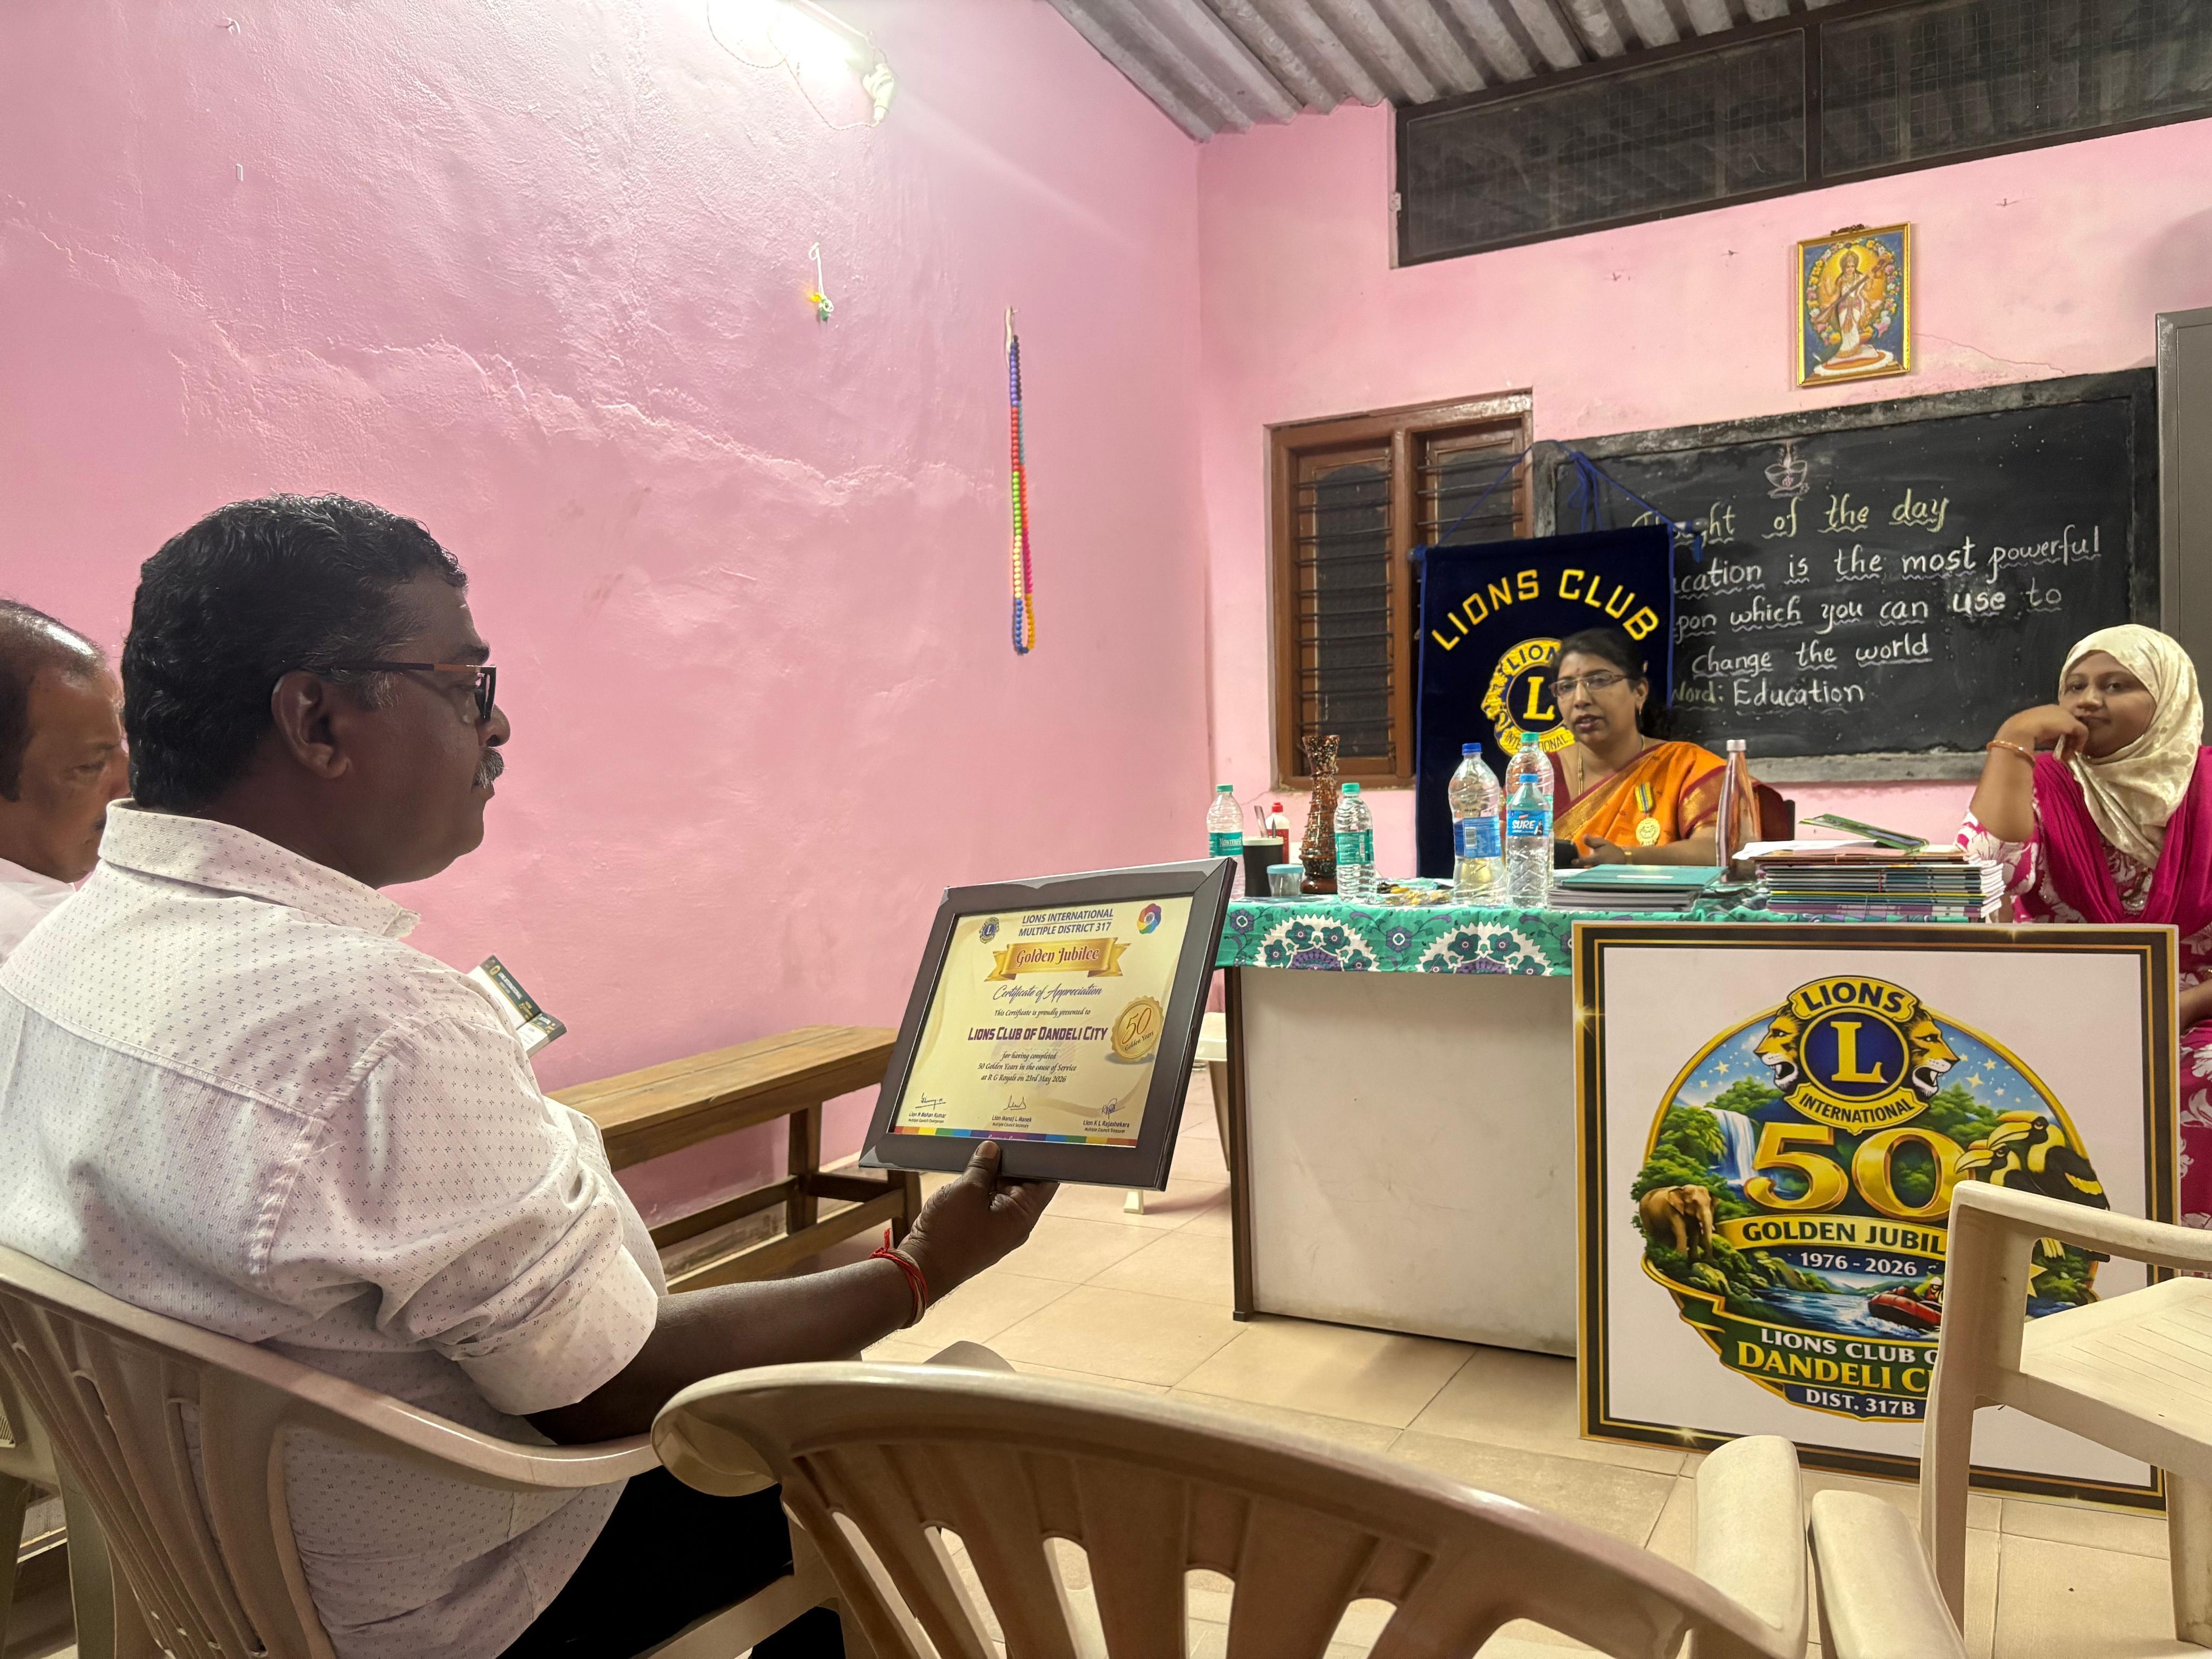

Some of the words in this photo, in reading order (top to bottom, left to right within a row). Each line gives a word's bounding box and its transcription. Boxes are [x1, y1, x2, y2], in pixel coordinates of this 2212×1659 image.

[1773, 496, 1804, 538] of
[1823, 493, 1870, 528] the
[1891, 488, 1949, 532] day
[1788, 554, 1808, 578] is
[1834, 543, 1884, 575] the
[1901, 535, 1977, 573] most
[1986, 524, 2100, 584] powerful
[1431, 569, 1539, 651] LIONS
[1559, 569, 1660, 641] CLUB
[1730, 595, 1802, 625] which
[1814, 600, 1862, 634] you
[1879, 600, 1928, 619] can
[1953, 590, 2006, 614] use
[2025, 577, 2062, 607] to
[1796, 640, 1837, 666] the
[1855, 633, 1929, 660] world
[1522, 676, 1555, 720] L
[1733, 677, 1864, 707] Education
[1512, 819, 1536, 830] SURE
[1018, 925, 1058, 937] MULTIPLE
[1057, 923, 1096, 934] DISTRICT
[1096, 921, 1112, 932] 317
[1022, 914, 1046, 924] LIONS
[1047, 909, 1113, 921] INTERNATIONAL
[1016, 949, 1055, 968] Golden
[1055, 945, 1099, 965] Jubilee
[993, 985, 1036, 1004] Certificate
[1035, 985, 1046, 1004] of
[1043, 983, 1102, 1003] Appreciation
[1800, 982, 1905, 1013] LIONS
[1005, 1009, 1032, 1019] Certificate
[1036, 1008, 1058, 1018] proudly
[1058, 1007, 1084, 1018] presented
[1121, 1007, 1152, 1044] 50
[968, 1027, 995, 1041] LIONS
[996, 1027, 1023, 1041] CLUB
[1037, 1026, 1083, 1041] DANDELI
[1083, 1026, 1108, 1041] CITY
[1002, 1051, 1011, 1061] for
[1011, 1051, 1029, 1061] having
[1030, 1051, 1057, 1062] completed
[1831, 1021, 1888, 1084] L
[999, 1075, 1017, 1083] Royals
[1038, 1075, 1052, 1085] May
[1050, 1063, 1058, 1073] of
[1799, 1093, 1915, 1123] INTERNATIONAL
[1744, 1121, 1976, 1221] 50
[1742, 1221, 1855, 1242] GOLDEN
[1800, 1252, 1848, 1270] 1976
[1865, 1258, 1917, 1276] 2026
[1762, 1328, 1837, 1354] LIONS
[1845, 1343, 1916, 1363] CLUB
[1737, 1340, 1891, 1390] DANDELI
[1806, 1389, 1859, 1410] DIST.
[1865, 1398, 1916, 1415] 317B
